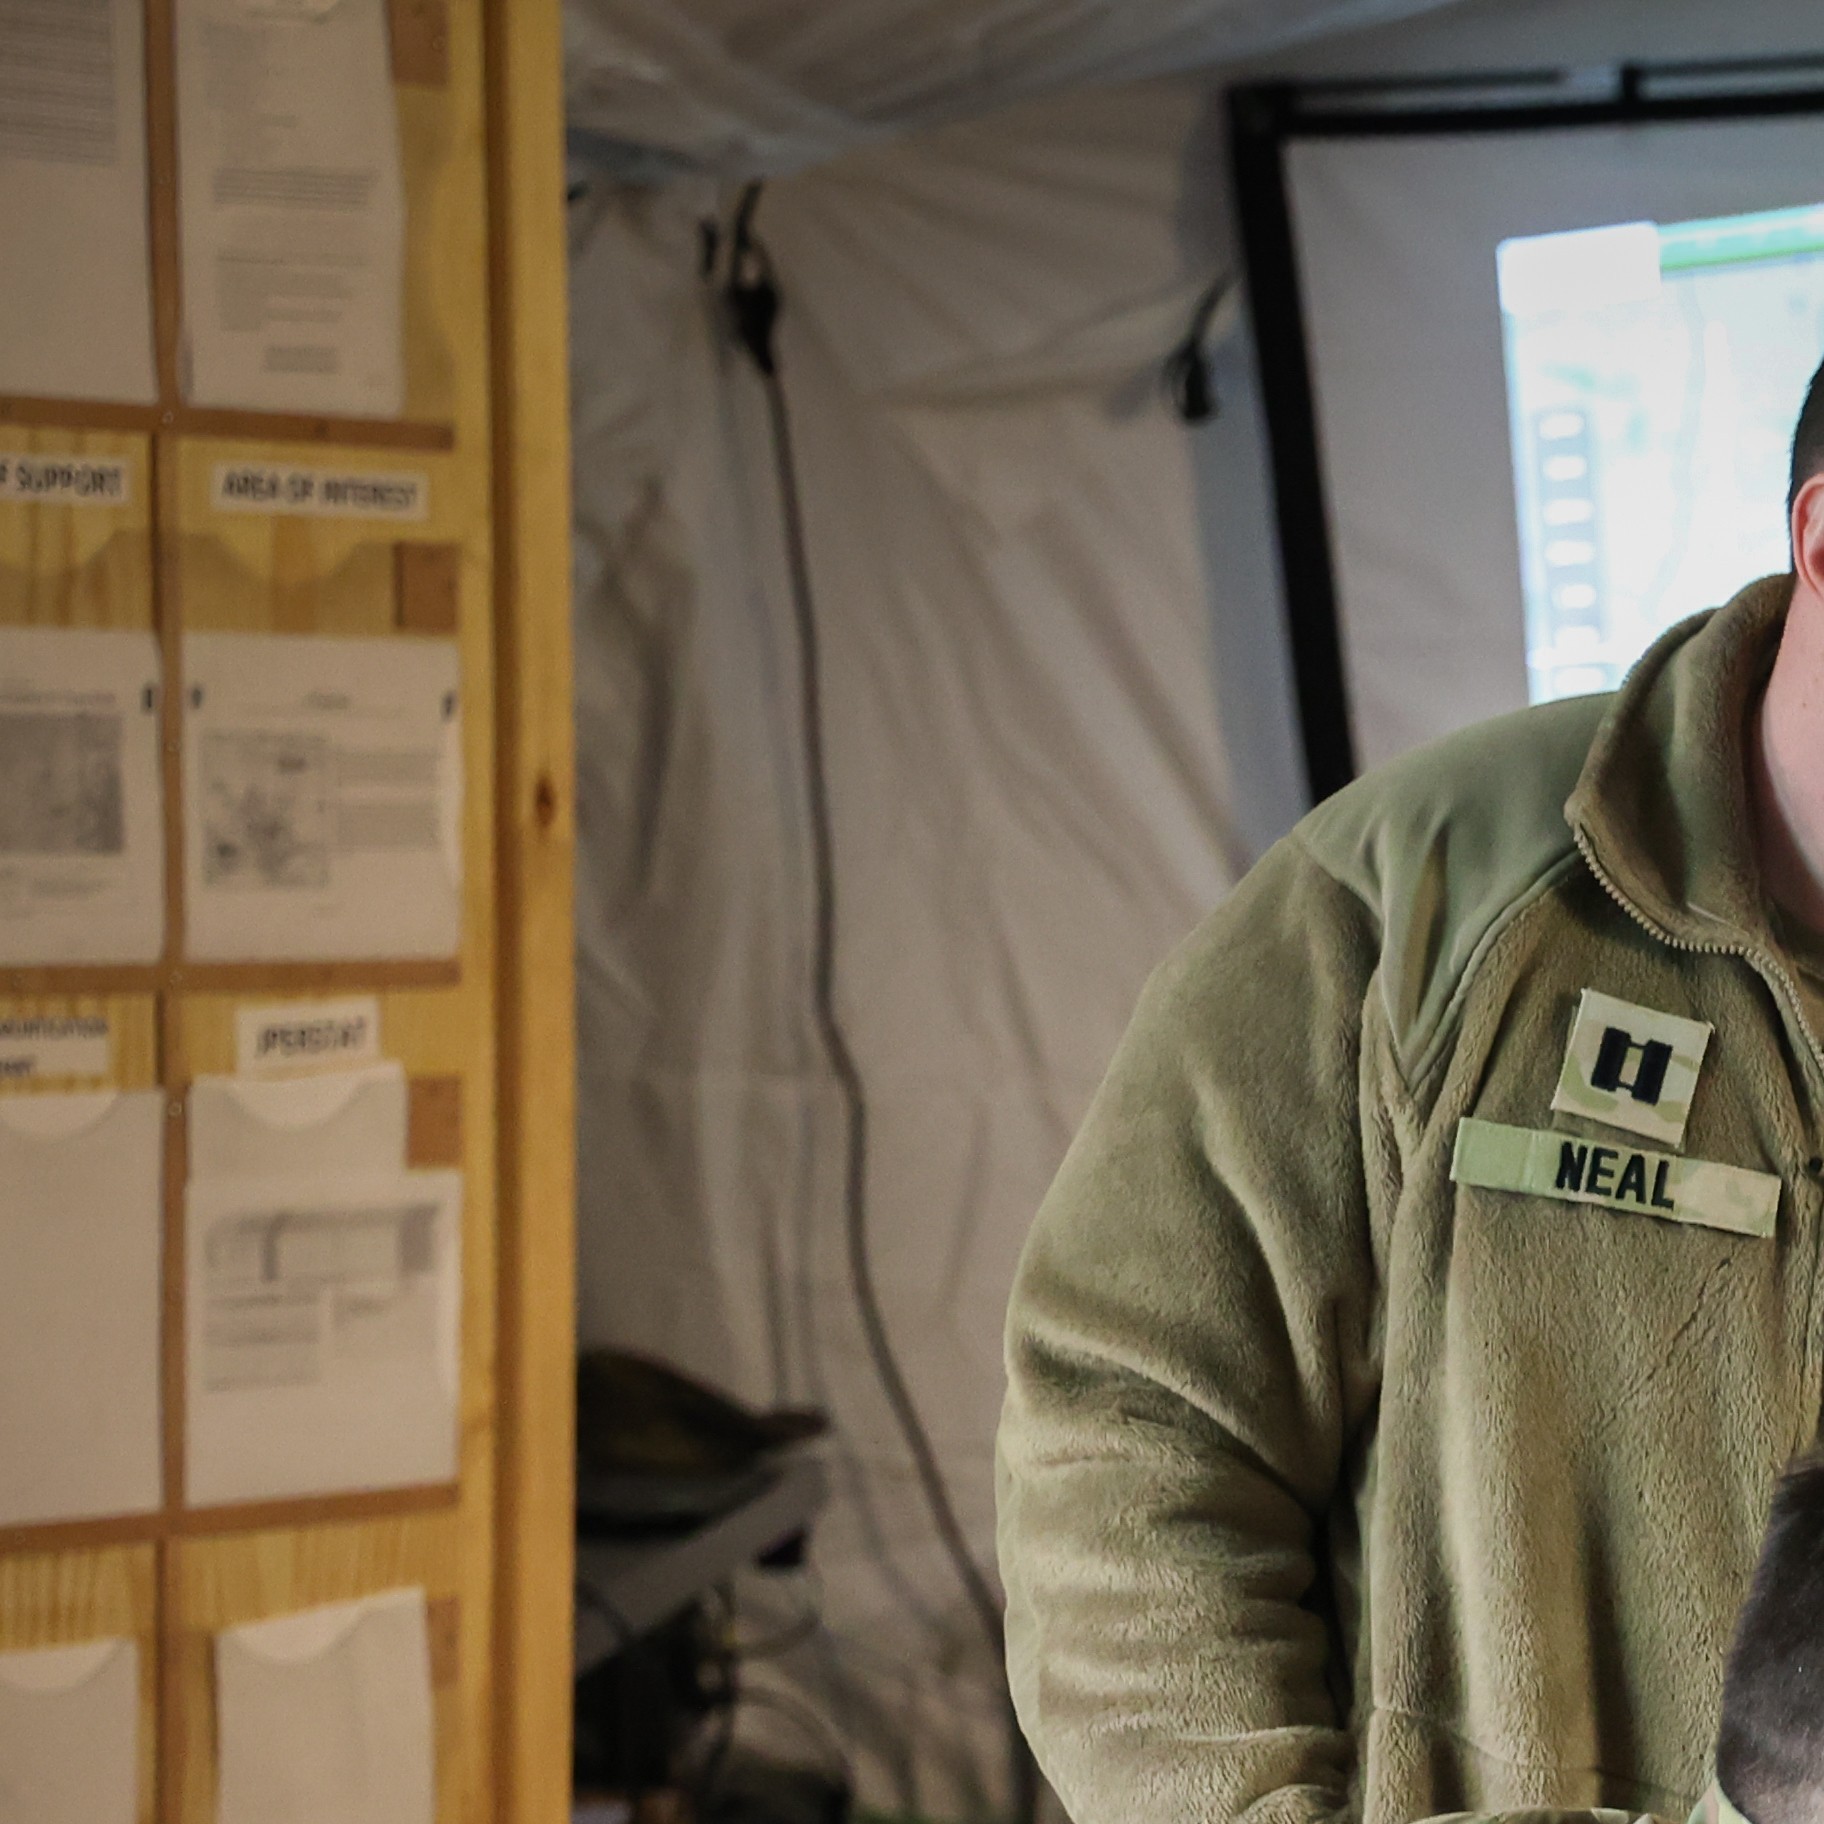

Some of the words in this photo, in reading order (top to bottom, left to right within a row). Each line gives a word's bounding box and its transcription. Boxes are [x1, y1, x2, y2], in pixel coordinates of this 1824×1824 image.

[16, 460, 122, 496] SUPPORT
[222, 470, 278, 498] AREA
[288, 473, 314, 502] OF
[324, 477, 417, 510] INTEREST
[1555, 1141, 1675, 1211] NEAL
